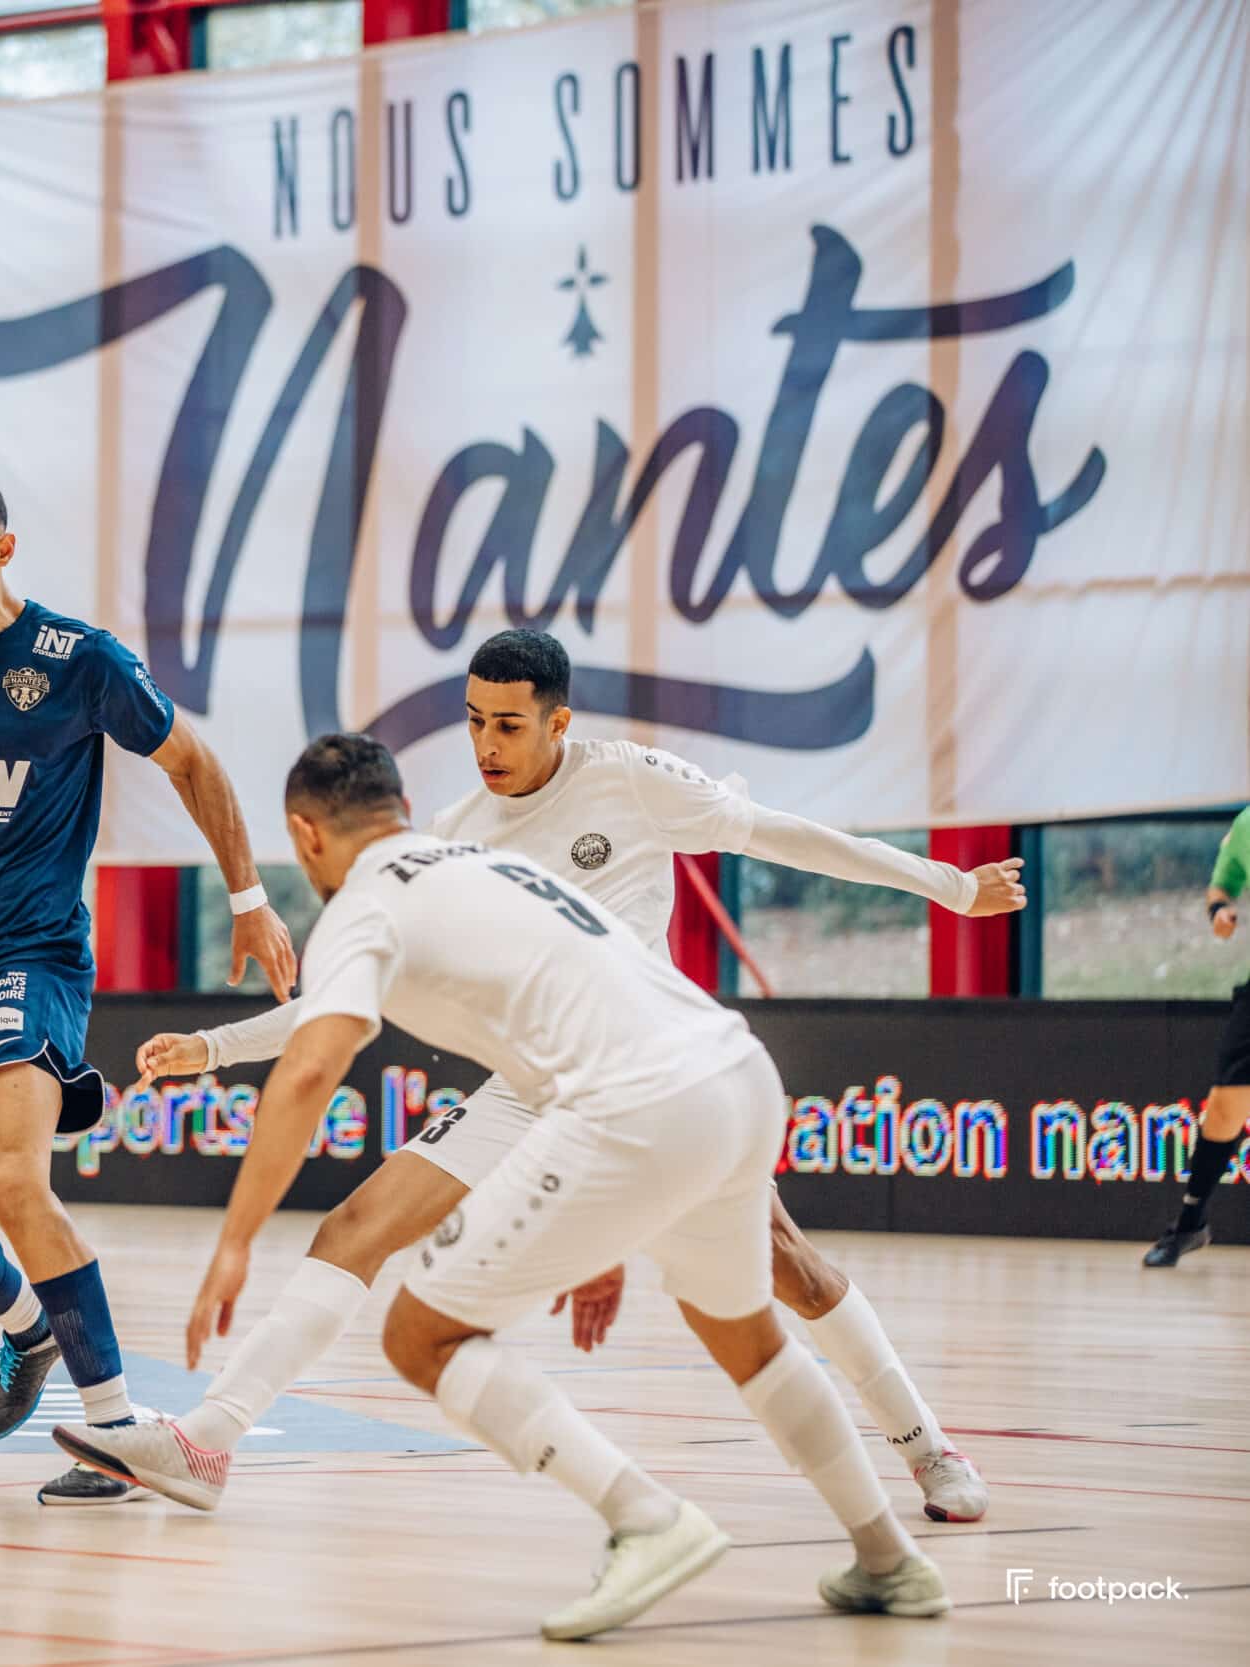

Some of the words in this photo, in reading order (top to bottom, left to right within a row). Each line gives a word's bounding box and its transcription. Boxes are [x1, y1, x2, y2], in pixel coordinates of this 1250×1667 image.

[272, 89, 472, 240] NOUS
[551, 24, 918, 202] SOMMES
[488, 863, 610, 937] 9
[53, 1072, 261, 1178] ports
[1029, 1099, 1250, 1184] nan
